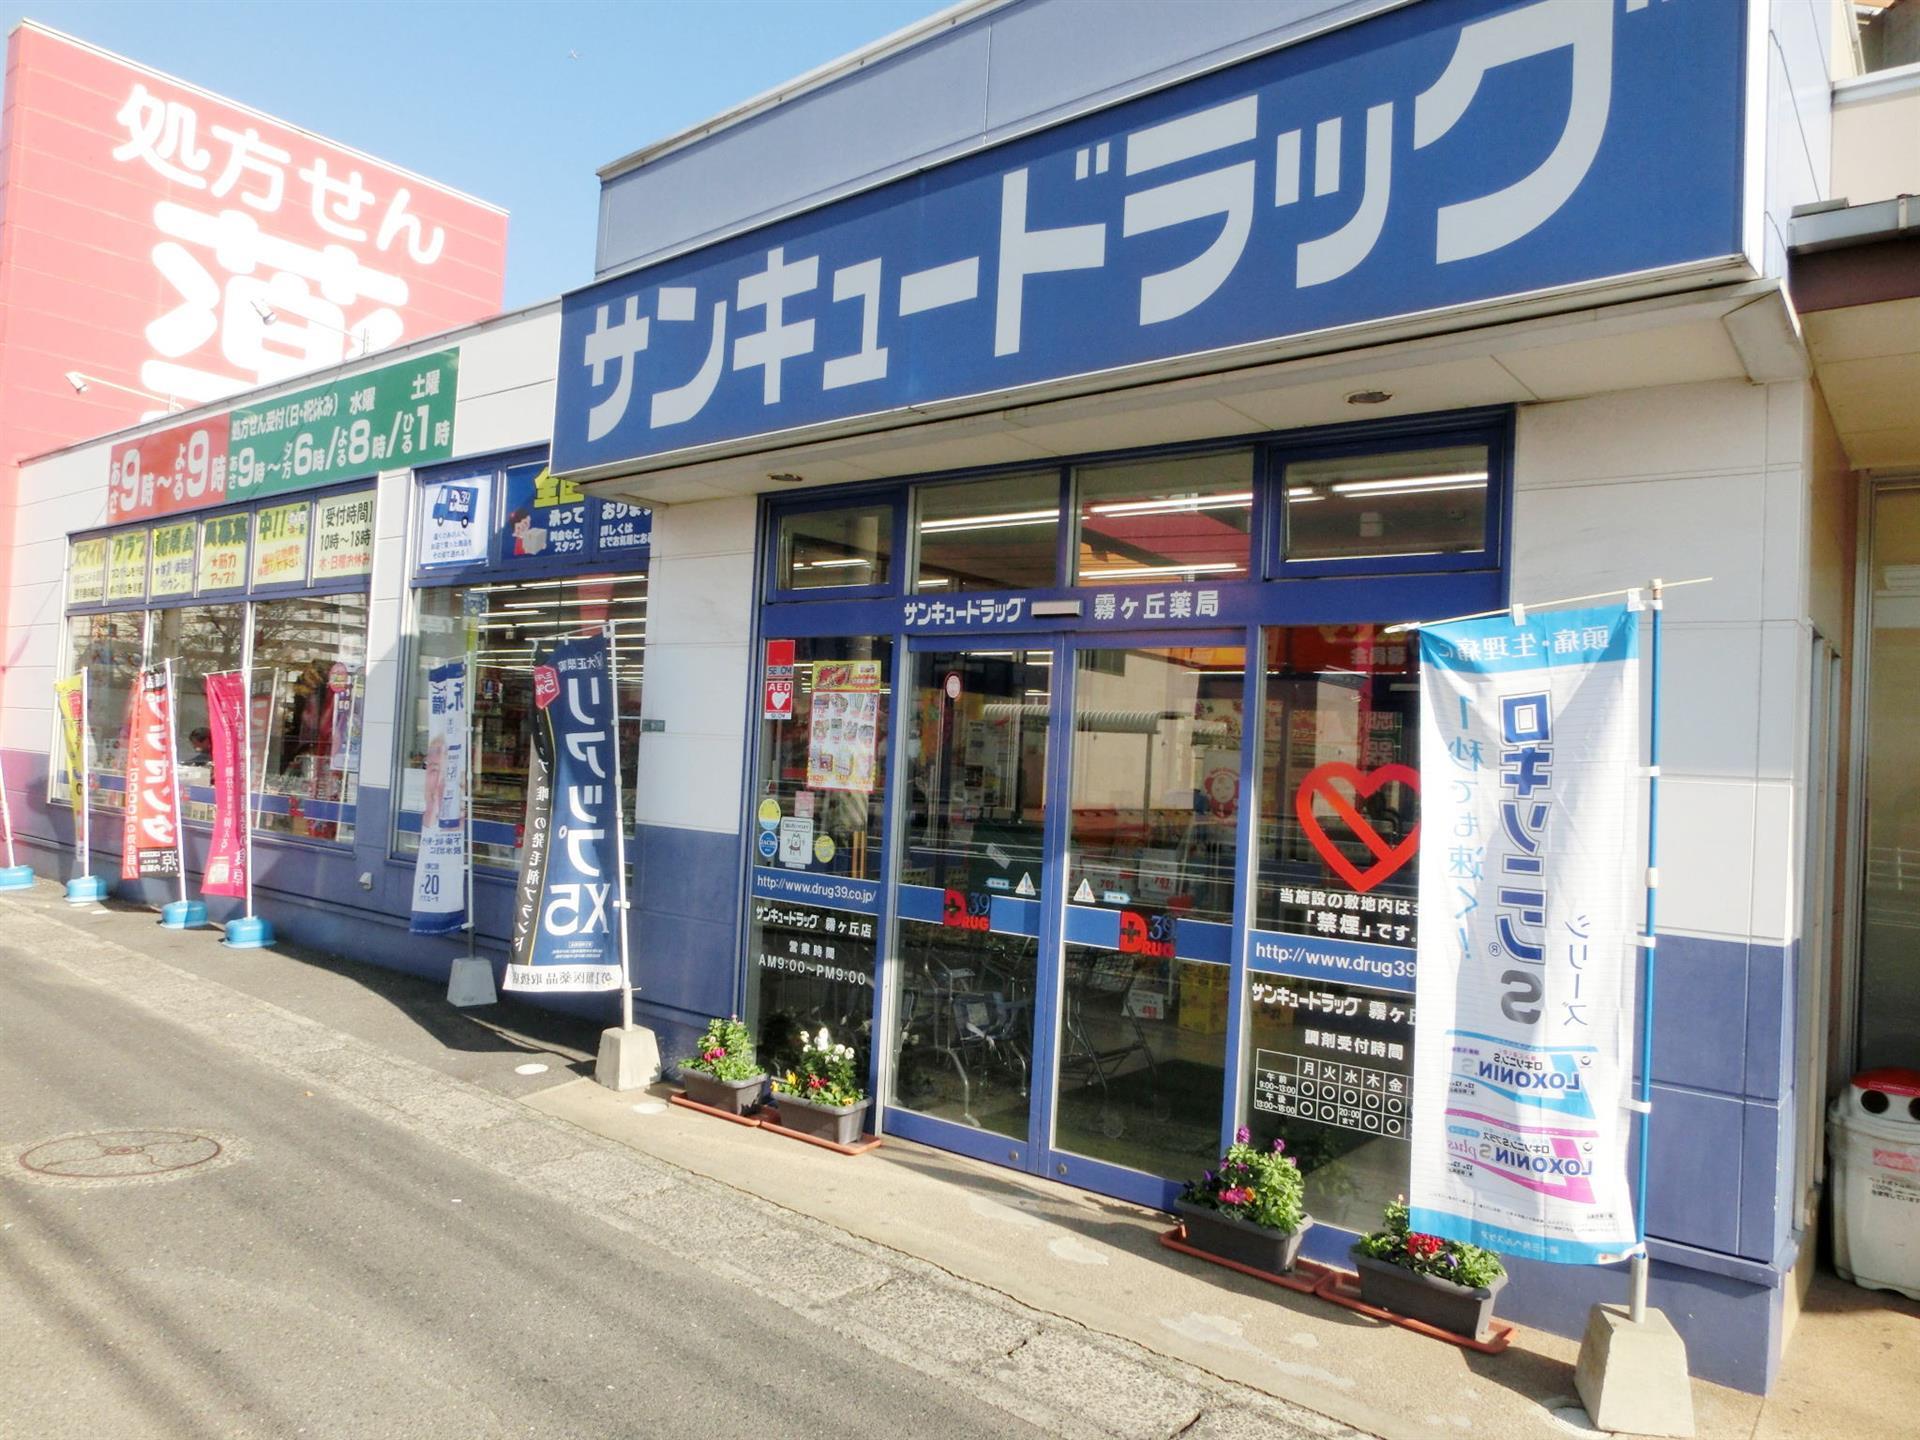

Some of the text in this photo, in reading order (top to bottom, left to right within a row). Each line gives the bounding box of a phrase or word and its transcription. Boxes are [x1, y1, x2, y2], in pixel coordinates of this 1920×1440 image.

[112, 84, 444, 264] 処方せん
[584, 0, 1668, 443] サンキュードラッグ
[350, 387, 375, 415] 水曜
[411, 369, 440, 400] 土曜
[904, 598, 1026, 626] サンキュードラッグ
[768, 667, 793, 676] SEOM
[768, 683, 791, 692] AED
[757, 875, 876, 903] http://www.drug39.co.jp/
[756, 905, 819, 928] サンキュードラッグ
[1306, 911, 1416, 943] 「禁煙」です。
[1252, 983, 1362, 1016] サンキュードラッグ
[1305, 1029, 1404, 1061] 調剤受付時間
[1303, 1062, 1403, 1093] 月 火 水 木 金
[1339, 1107, 1360, 1119] 20:00
